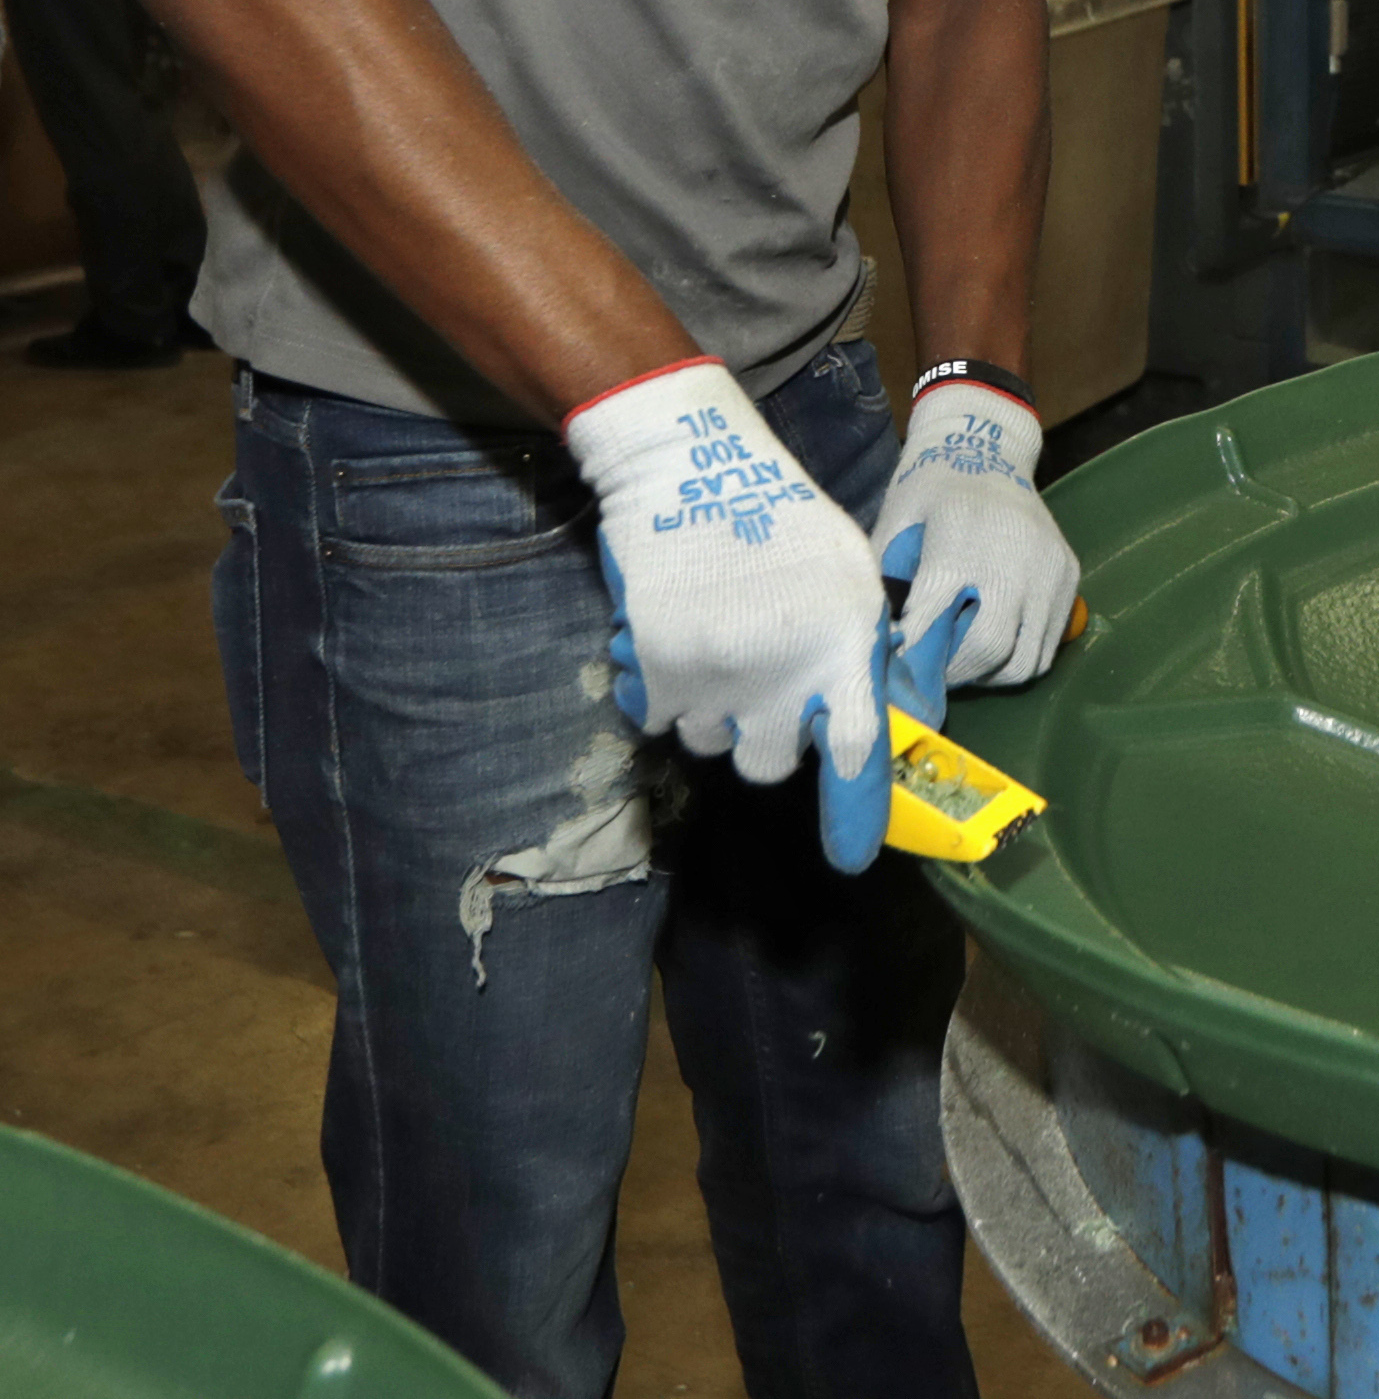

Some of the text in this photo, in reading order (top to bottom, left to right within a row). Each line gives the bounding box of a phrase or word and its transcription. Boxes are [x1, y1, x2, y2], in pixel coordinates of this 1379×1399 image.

[677, 407, 728, 439] 9/L
[691, 434, 753, 471] 300
[679, 460, 783, 504] ATLAS
[653, 483, 816, 532] SHOWA
